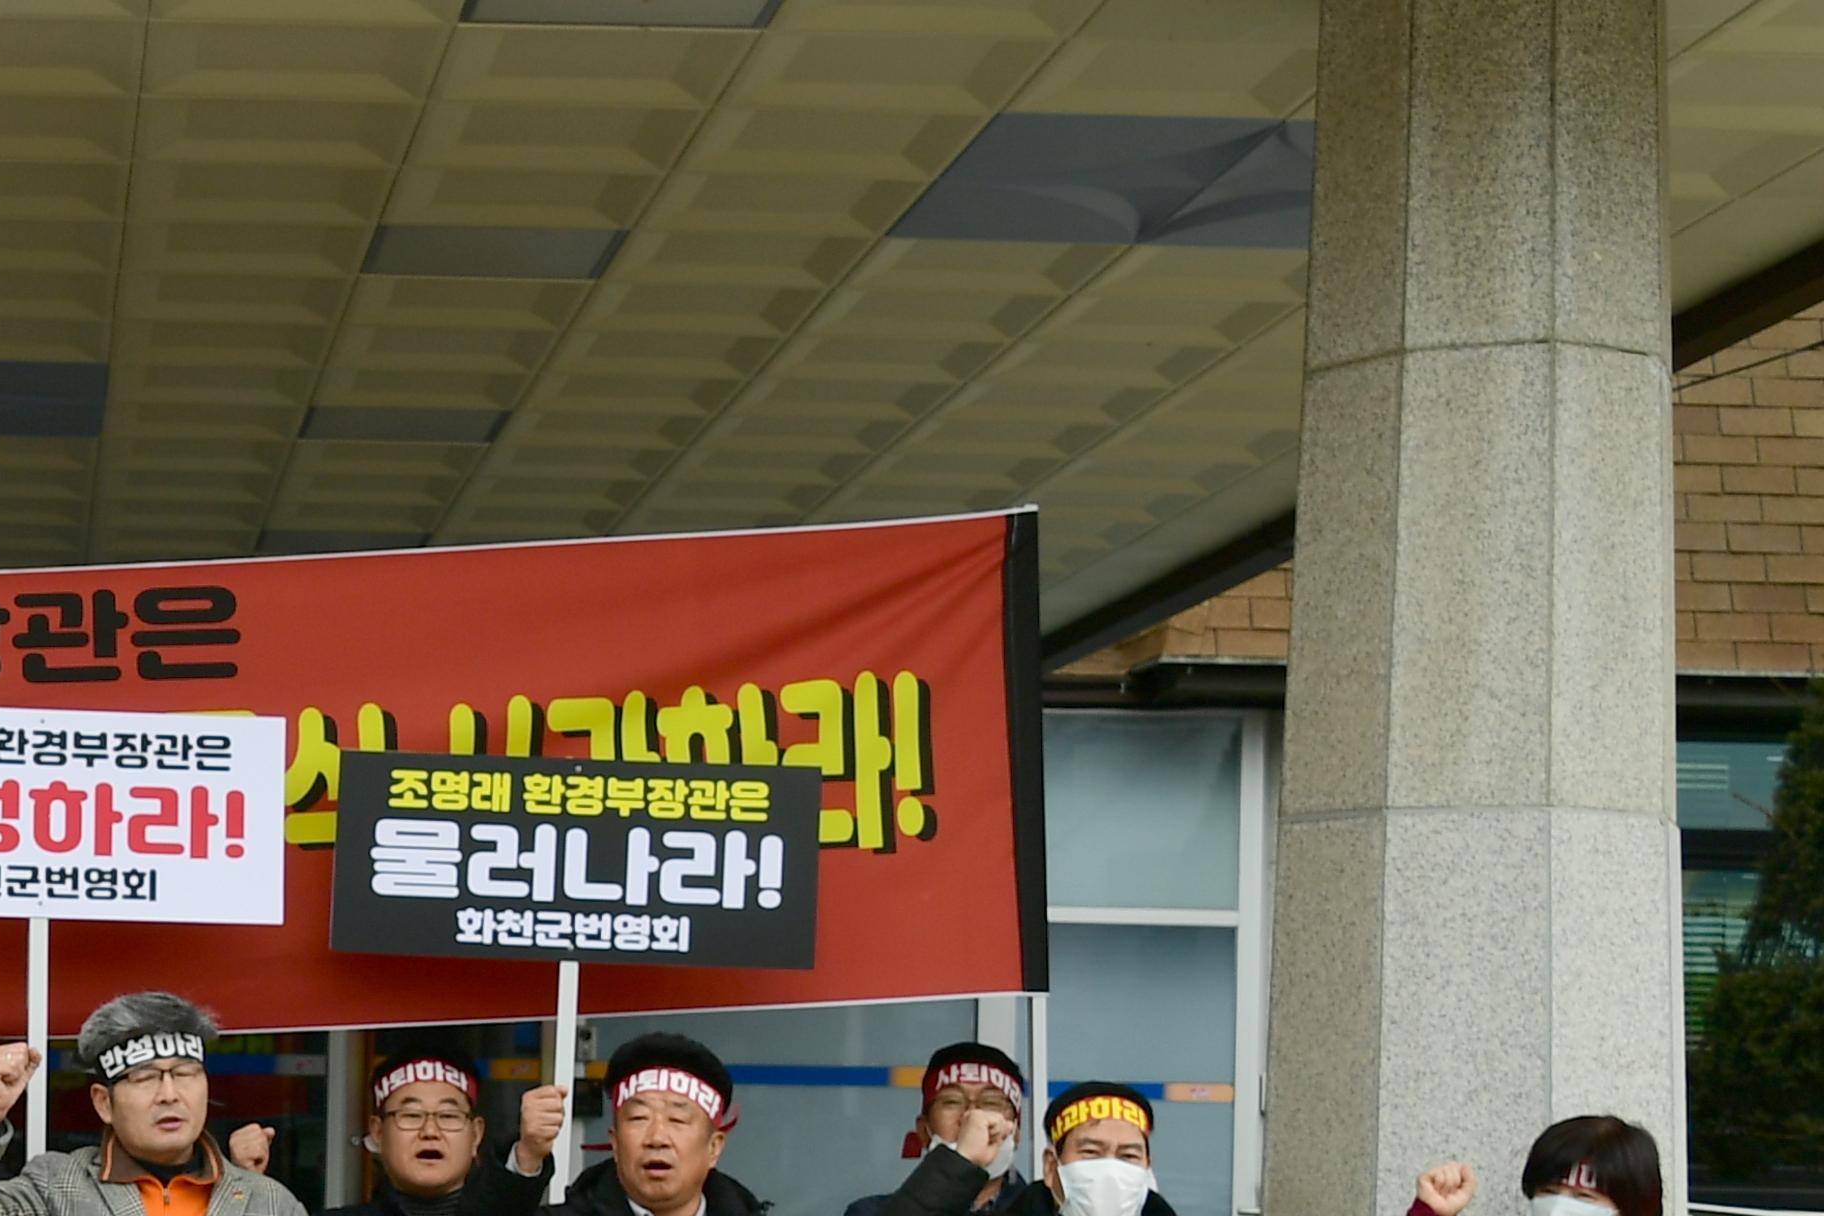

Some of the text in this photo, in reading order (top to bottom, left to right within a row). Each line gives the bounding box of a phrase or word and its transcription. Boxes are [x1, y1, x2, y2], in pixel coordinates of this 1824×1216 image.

[387, 768, 771, 823] 조명래 환경부장관은
[369, 817, 786, 911] 물러나라!
[455, 906, 692, 954] 화천군번영회
[374, 1060, 468, 1107] 사퇴하라
[617, 1068, 721, 1119] 사퇴하라
